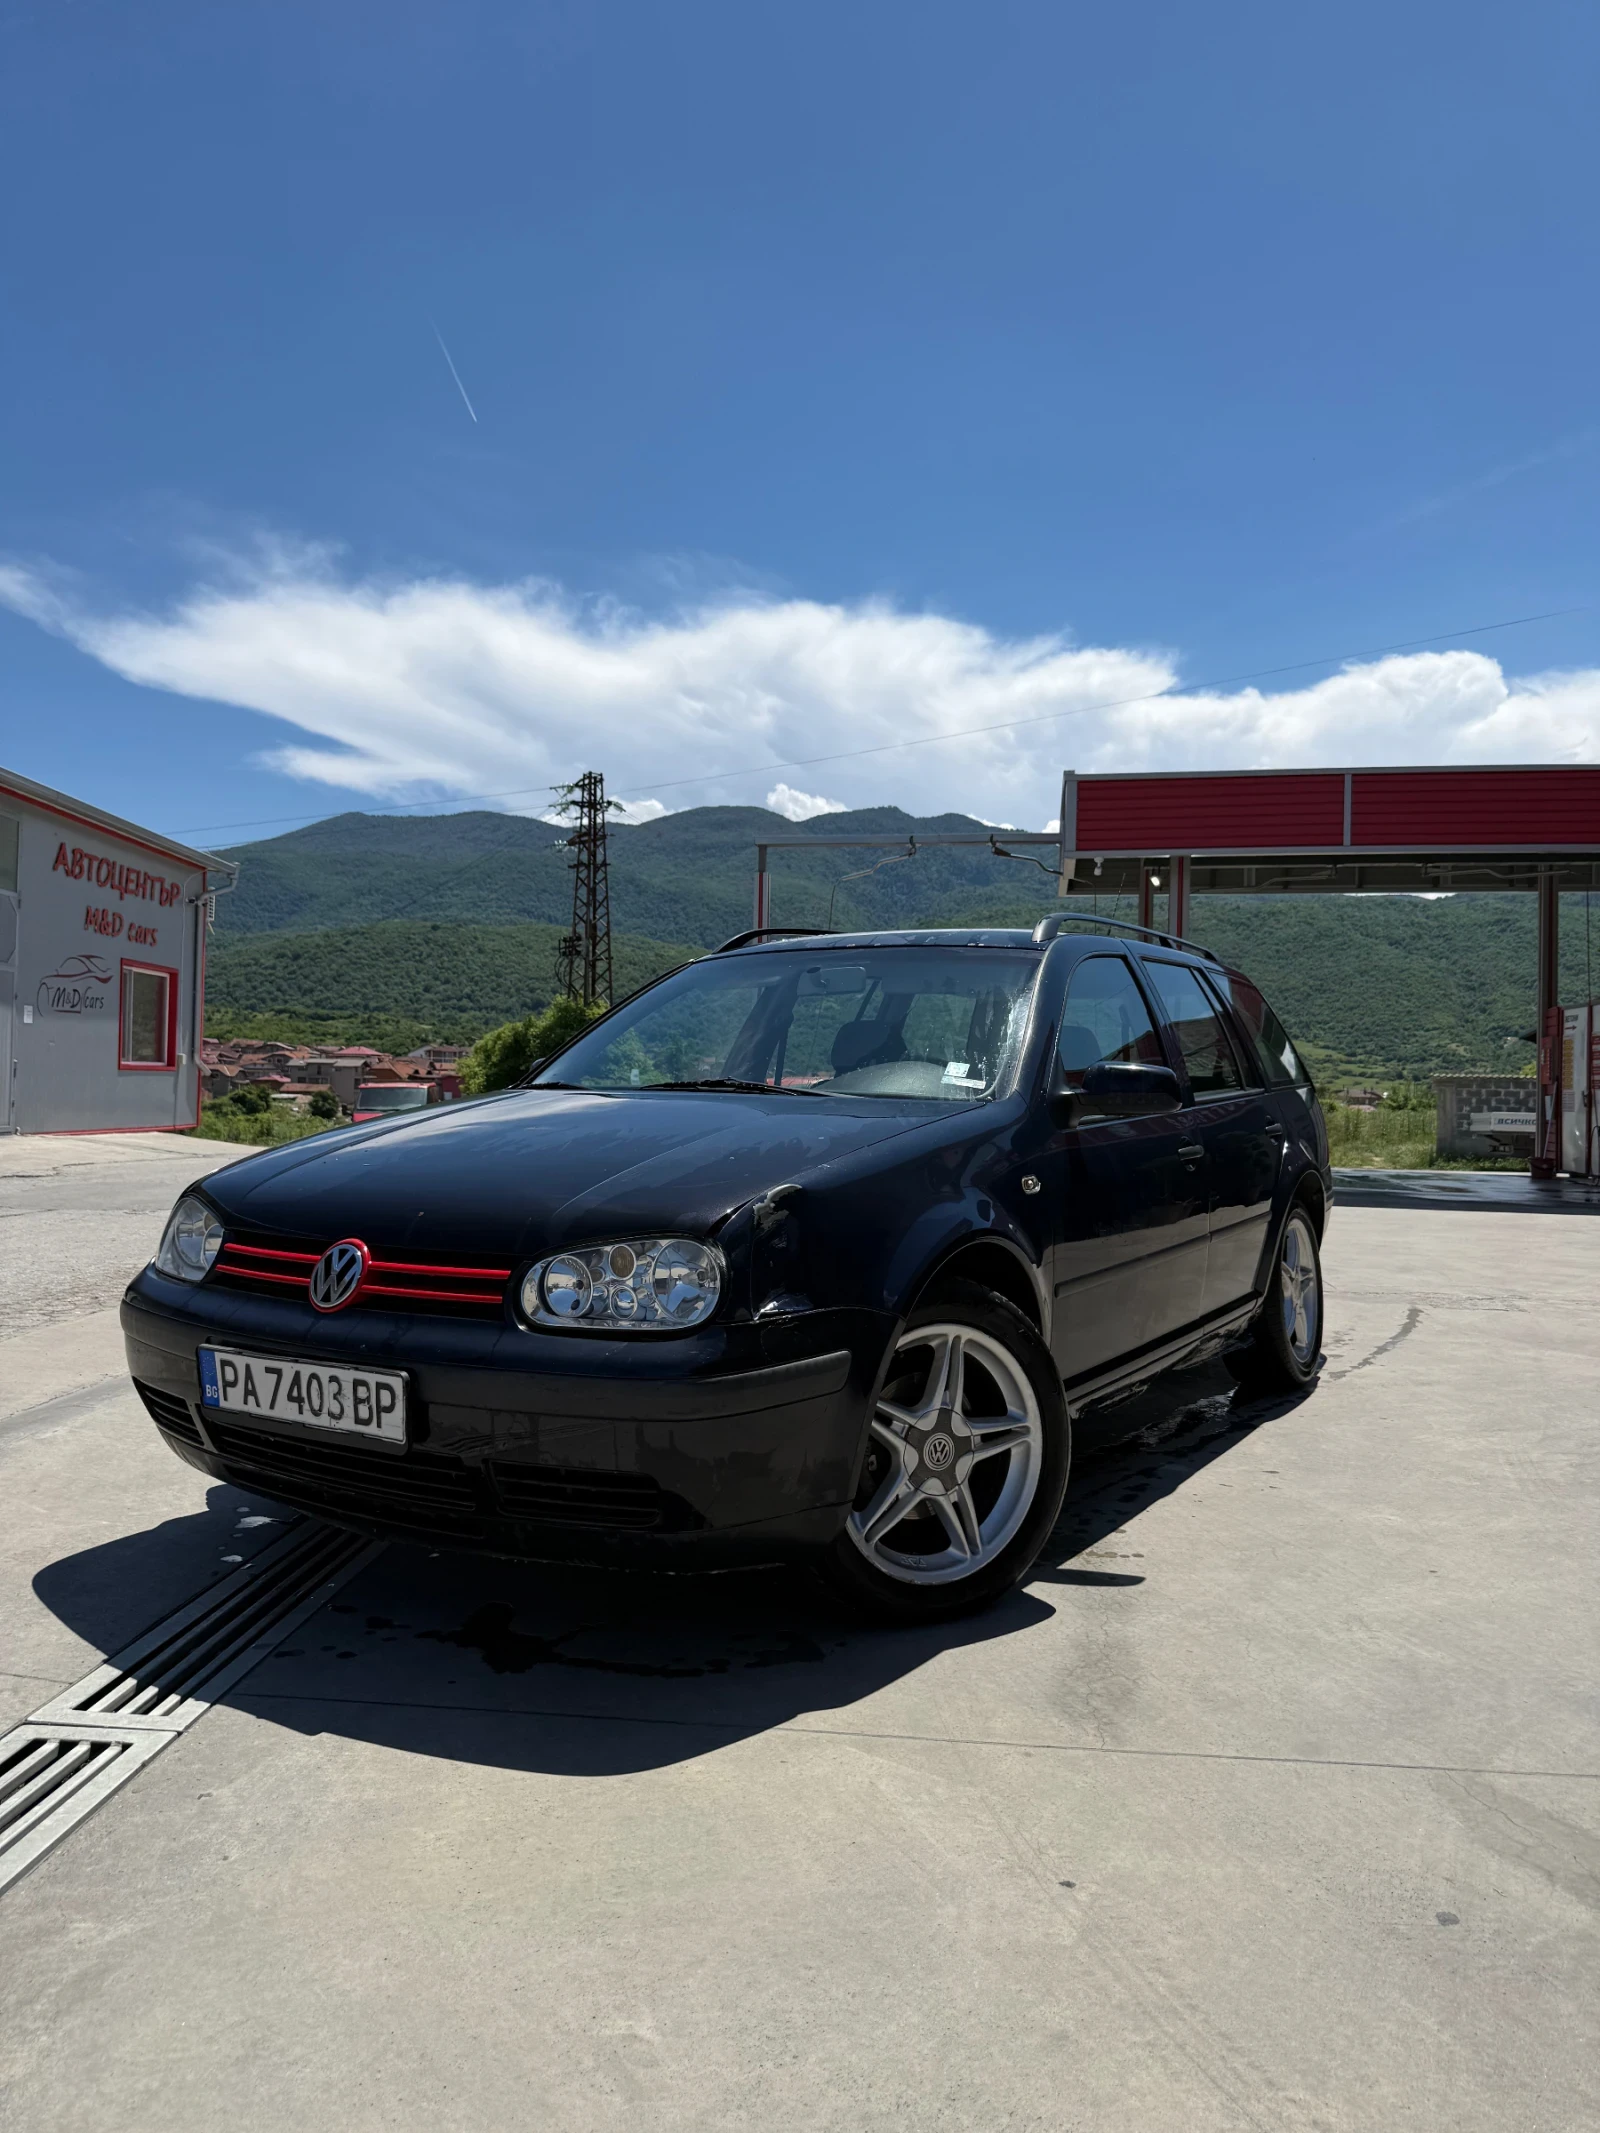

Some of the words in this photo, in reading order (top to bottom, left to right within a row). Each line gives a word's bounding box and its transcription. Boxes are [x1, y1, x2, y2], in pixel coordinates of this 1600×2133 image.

[52, 842, 181, 907] АВТОЦЕНТЪР
[84, 905, 124, 937] M&D
[128, 922, 158, 947] cars
[51, 986, 81, 1008] M&D
[84, 994, 104, 1009] cars
[206, 1385, 218, 1398] BG
